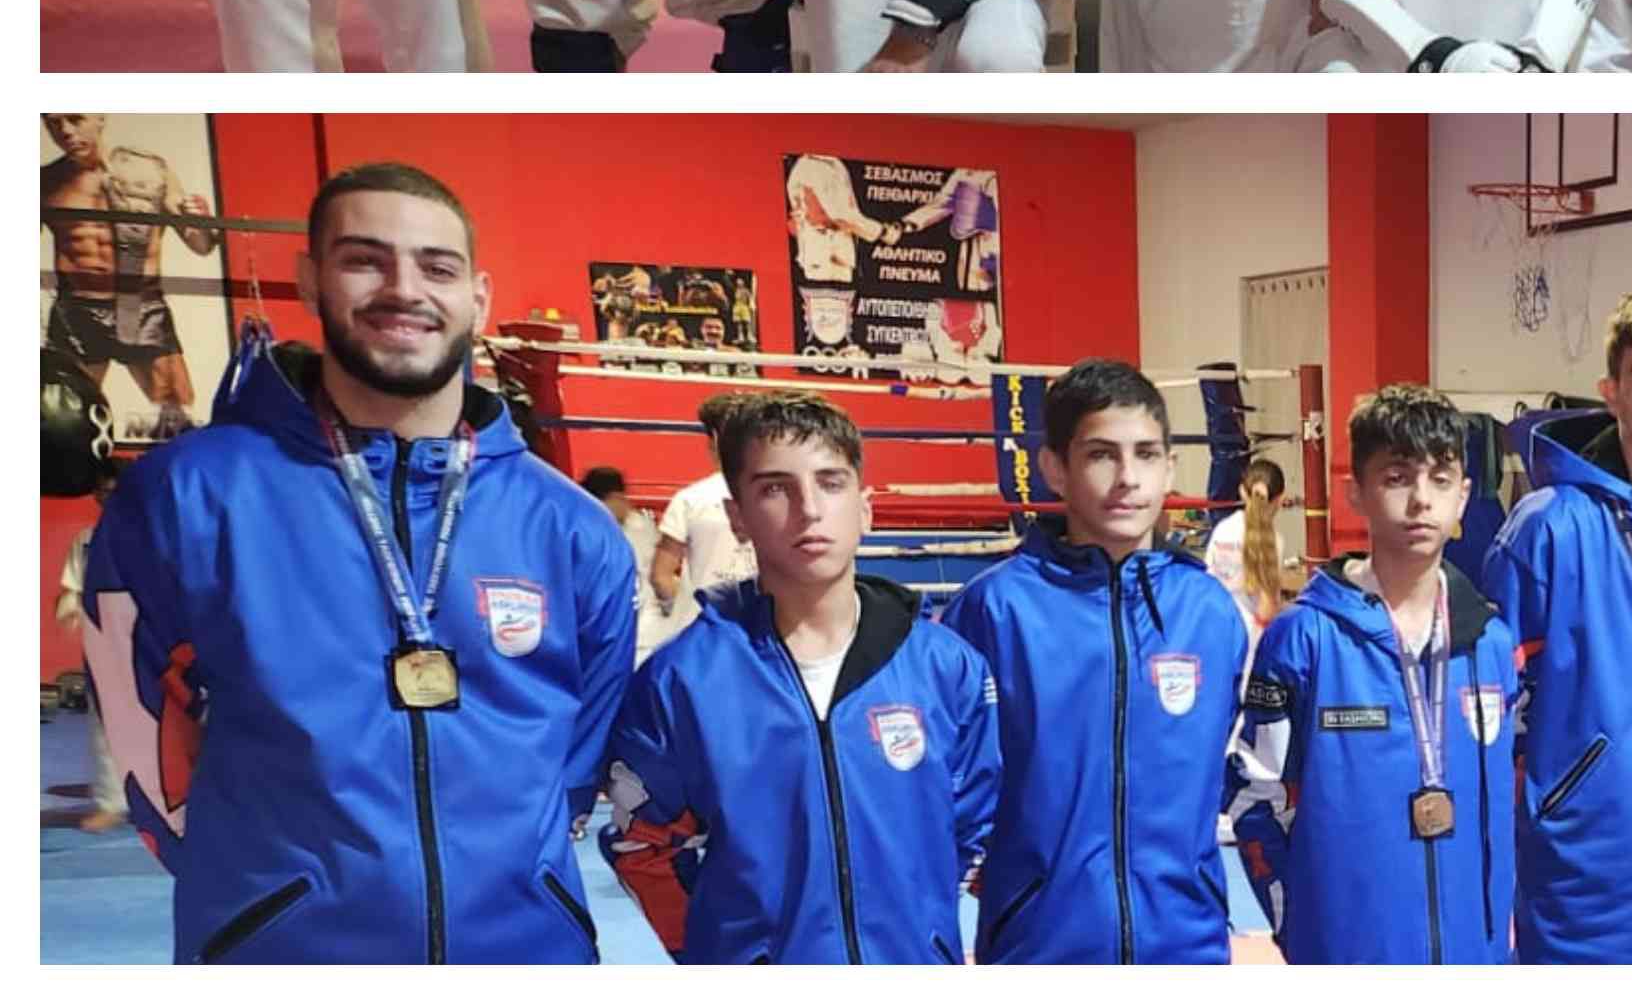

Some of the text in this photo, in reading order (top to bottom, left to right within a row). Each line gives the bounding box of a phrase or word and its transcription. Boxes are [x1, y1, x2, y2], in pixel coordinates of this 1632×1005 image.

[864, 166, 944, 184] ΣΕΒΑΣΜΟΣ
[872, 246, 947, 264] ΑΘΛΗΤΙΚΟ
[878, 266, 942, 283] ΠΝΕΥΜΑ
